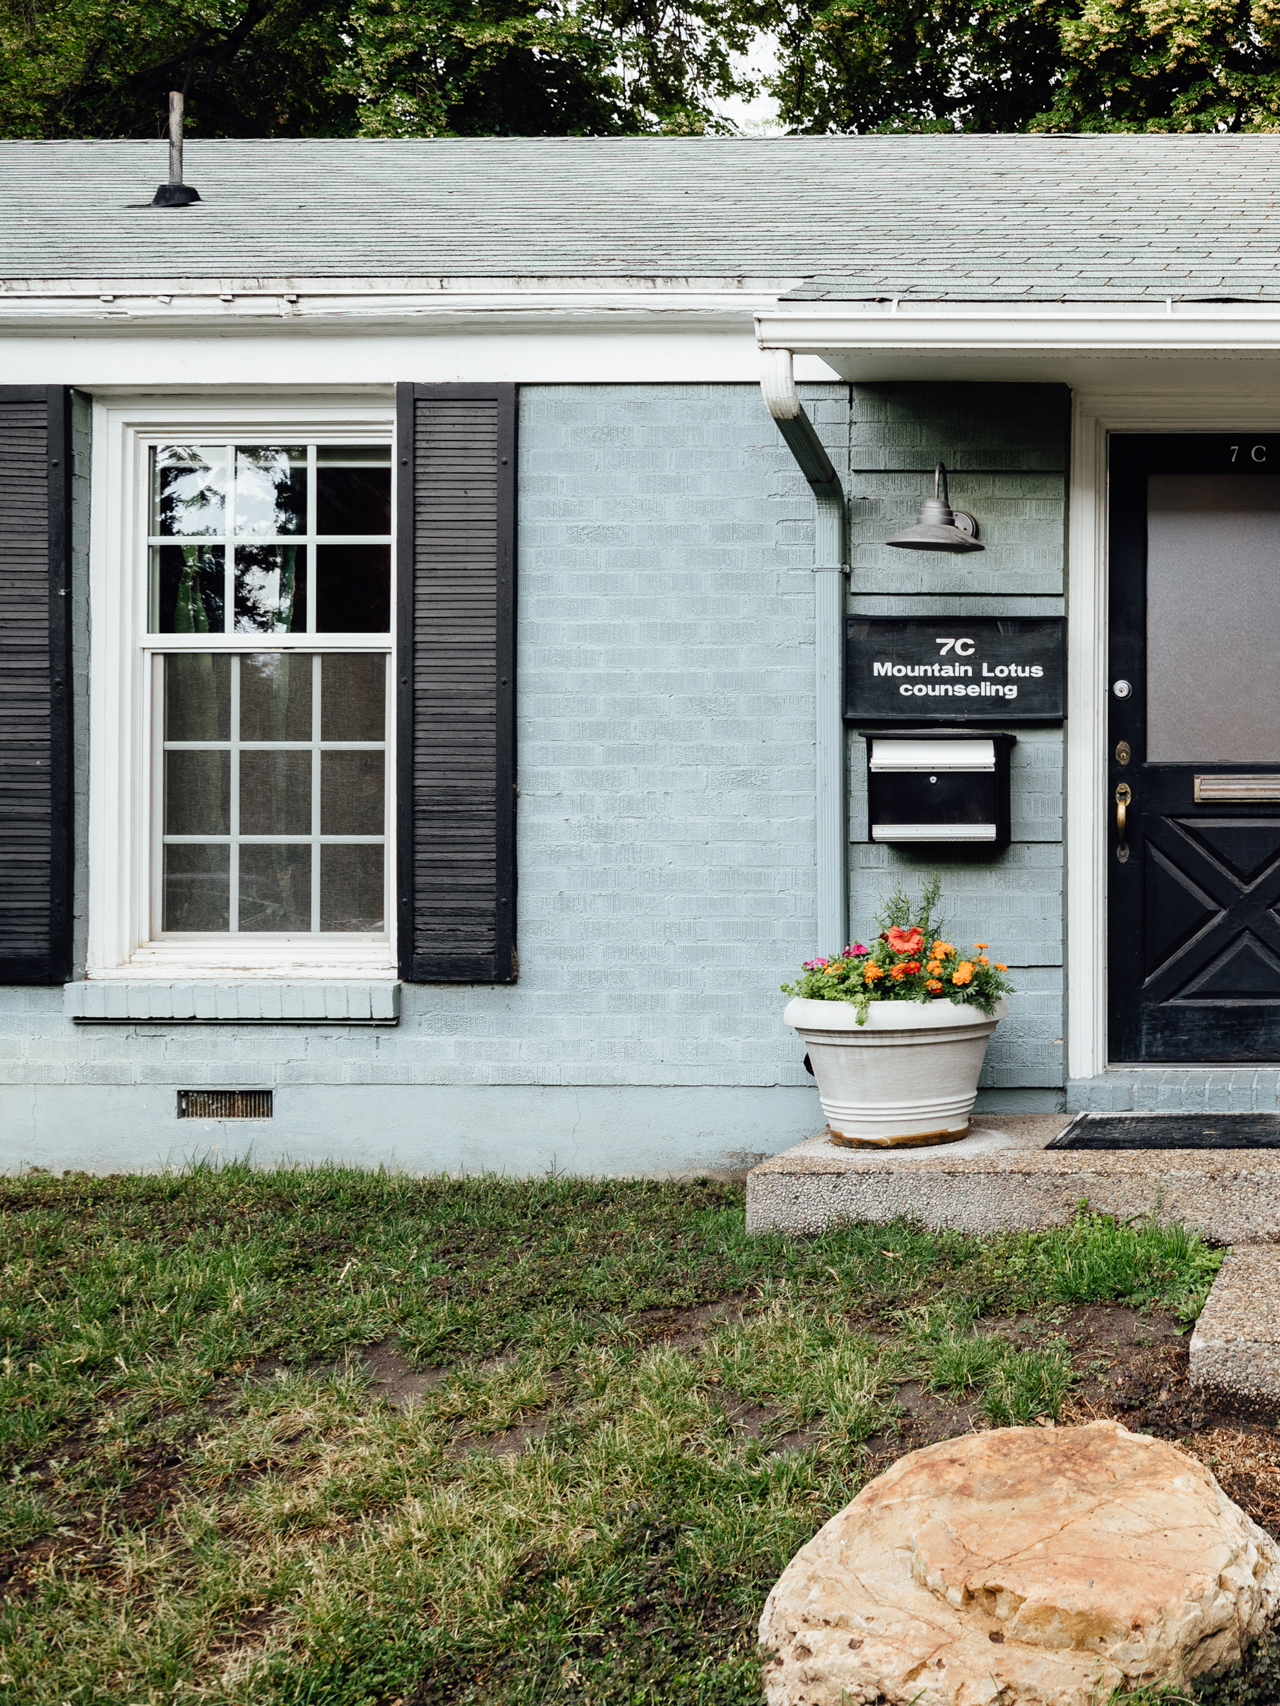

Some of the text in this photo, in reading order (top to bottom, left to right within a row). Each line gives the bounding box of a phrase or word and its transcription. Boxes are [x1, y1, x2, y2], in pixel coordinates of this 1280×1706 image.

[935, 638, 976, 656] 7C
[872, 662, 1044, 677] Mountain Lotus
[899, 681, 1018, 699] counseling
